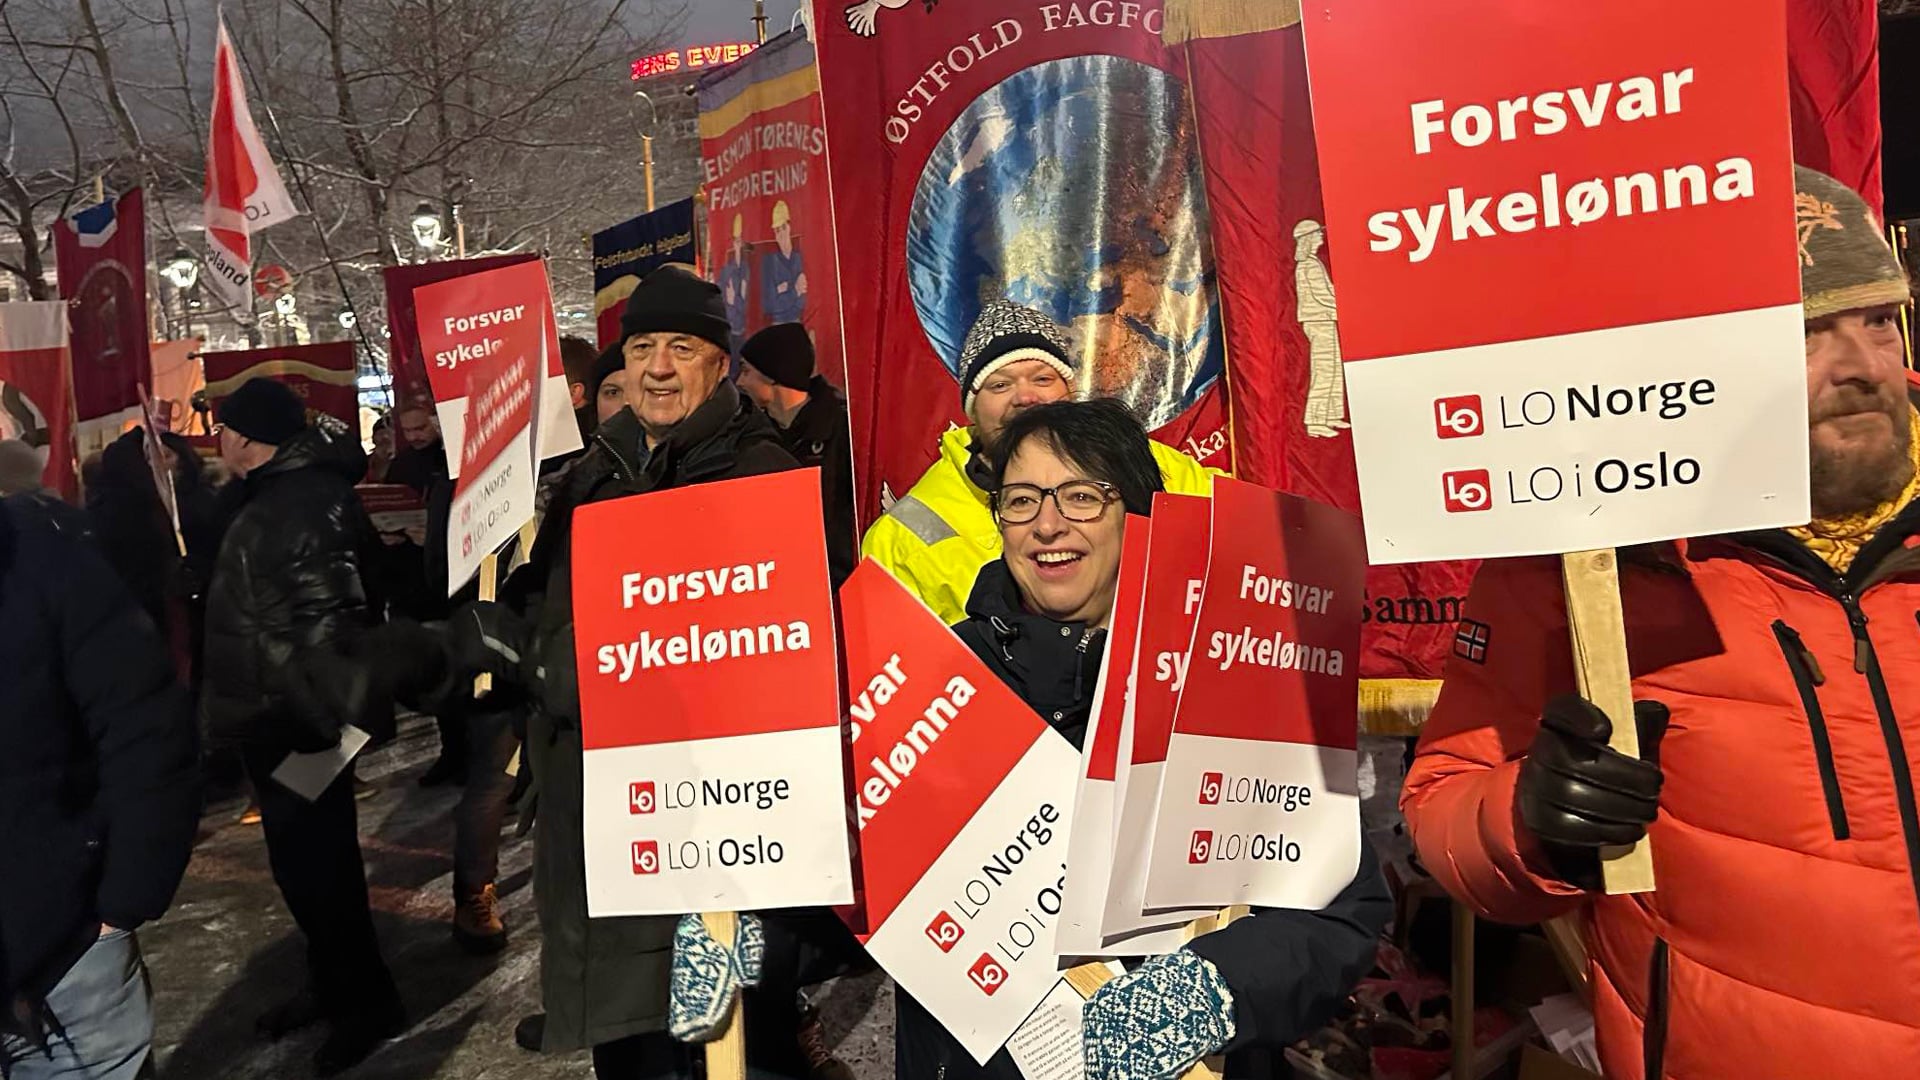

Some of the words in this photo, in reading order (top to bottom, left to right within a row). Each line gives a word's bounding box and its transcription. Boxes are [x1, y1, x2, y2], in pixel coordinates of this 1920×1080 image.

[885, 19, 1023, 144] ØSTFOLD
[1410, 67, 1694, 155] Forsvar
[1367, 156, 1755, 263] sykelønna
[444, 303, 525, 336] Forsvar
[1500, 391, 1555, 428] LO
[1567, 378, 1716, 420] Norge
[1508, 467, 1563, 503] LO
[1575, 463, 1581, 497] i
[1594, 451, 1701, 493] Oslo
[622, 560, 776, 609] Forsvar
[1240, 564, 1335, 615] Forsvar
[597, 619, 811, 683] sykelønna
[1208, 626, 1344, 677] sykelønna
[665, 780, 696, 809] LO
[702, 778, 789, 810] Norge
[1226, 777, 1251, 803] LO
[1252, 778, 1311, 812] Norge
[668, 841, 700, 870] LO
[706, 840, 711, 868] i
[718, 834, 784, 867] Oslo
[954, 879, 990, 920] LO
[982, 803, 1060, 887] Norge
[1216, 834, 1241, 861] LO
[1251, 833, 1301, 862] Oslo
[997, 921, 1035, 962] LO
